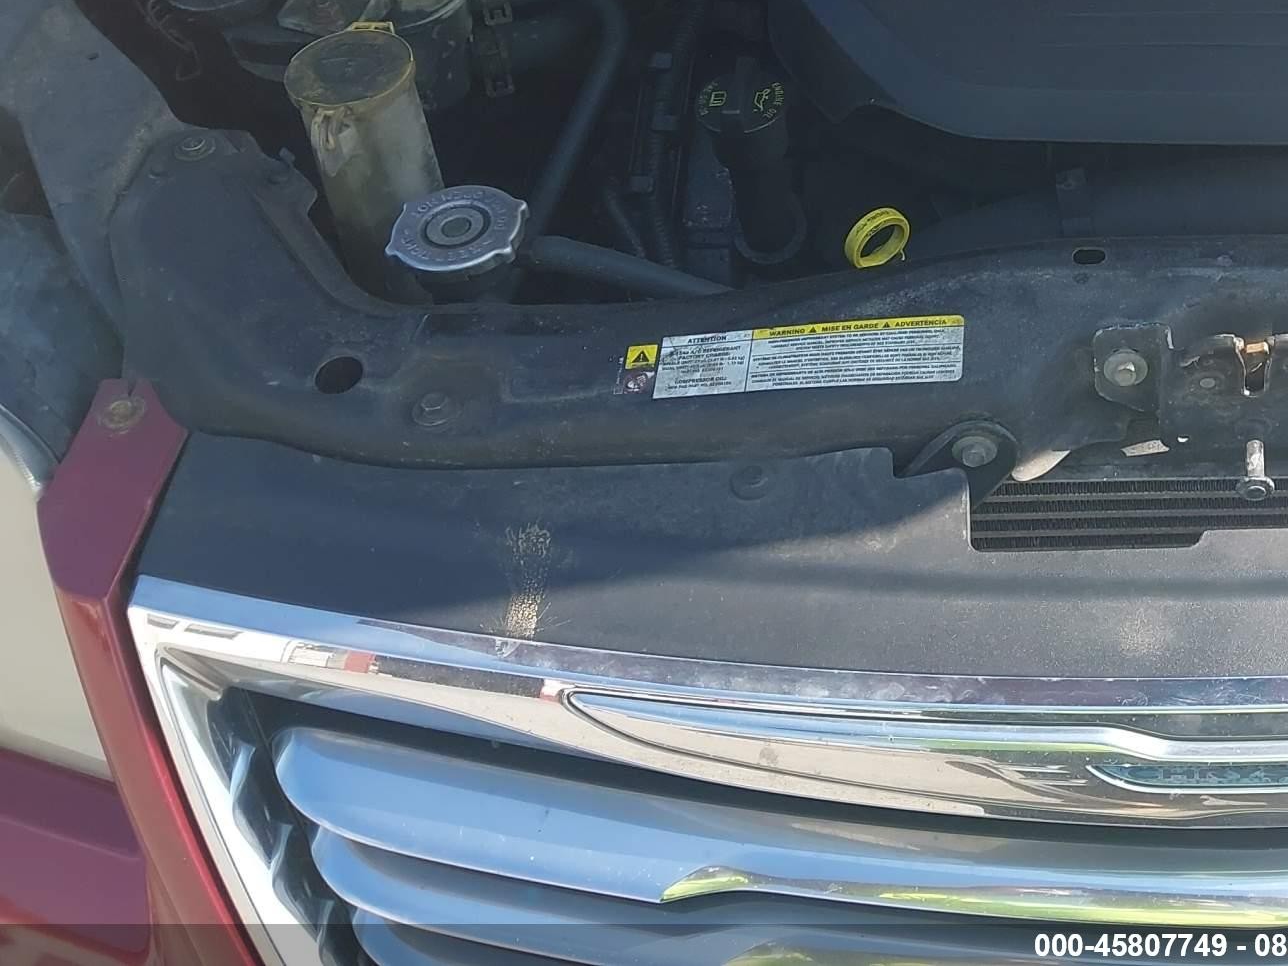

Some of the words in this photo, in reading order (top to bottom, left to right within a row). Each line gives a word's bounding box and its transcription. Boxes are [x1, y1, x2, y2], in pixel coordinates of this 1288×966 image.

[769, 328, 806, 337] WARNING
[821, 325, 840, 333] MISE
[841, 324, 852, 332] EN
[853, 322, 879, 331] GARDE
[894, 319, 948, 328] ADVERTENCIA
[687, 335, 727, 343] ATTENTION
